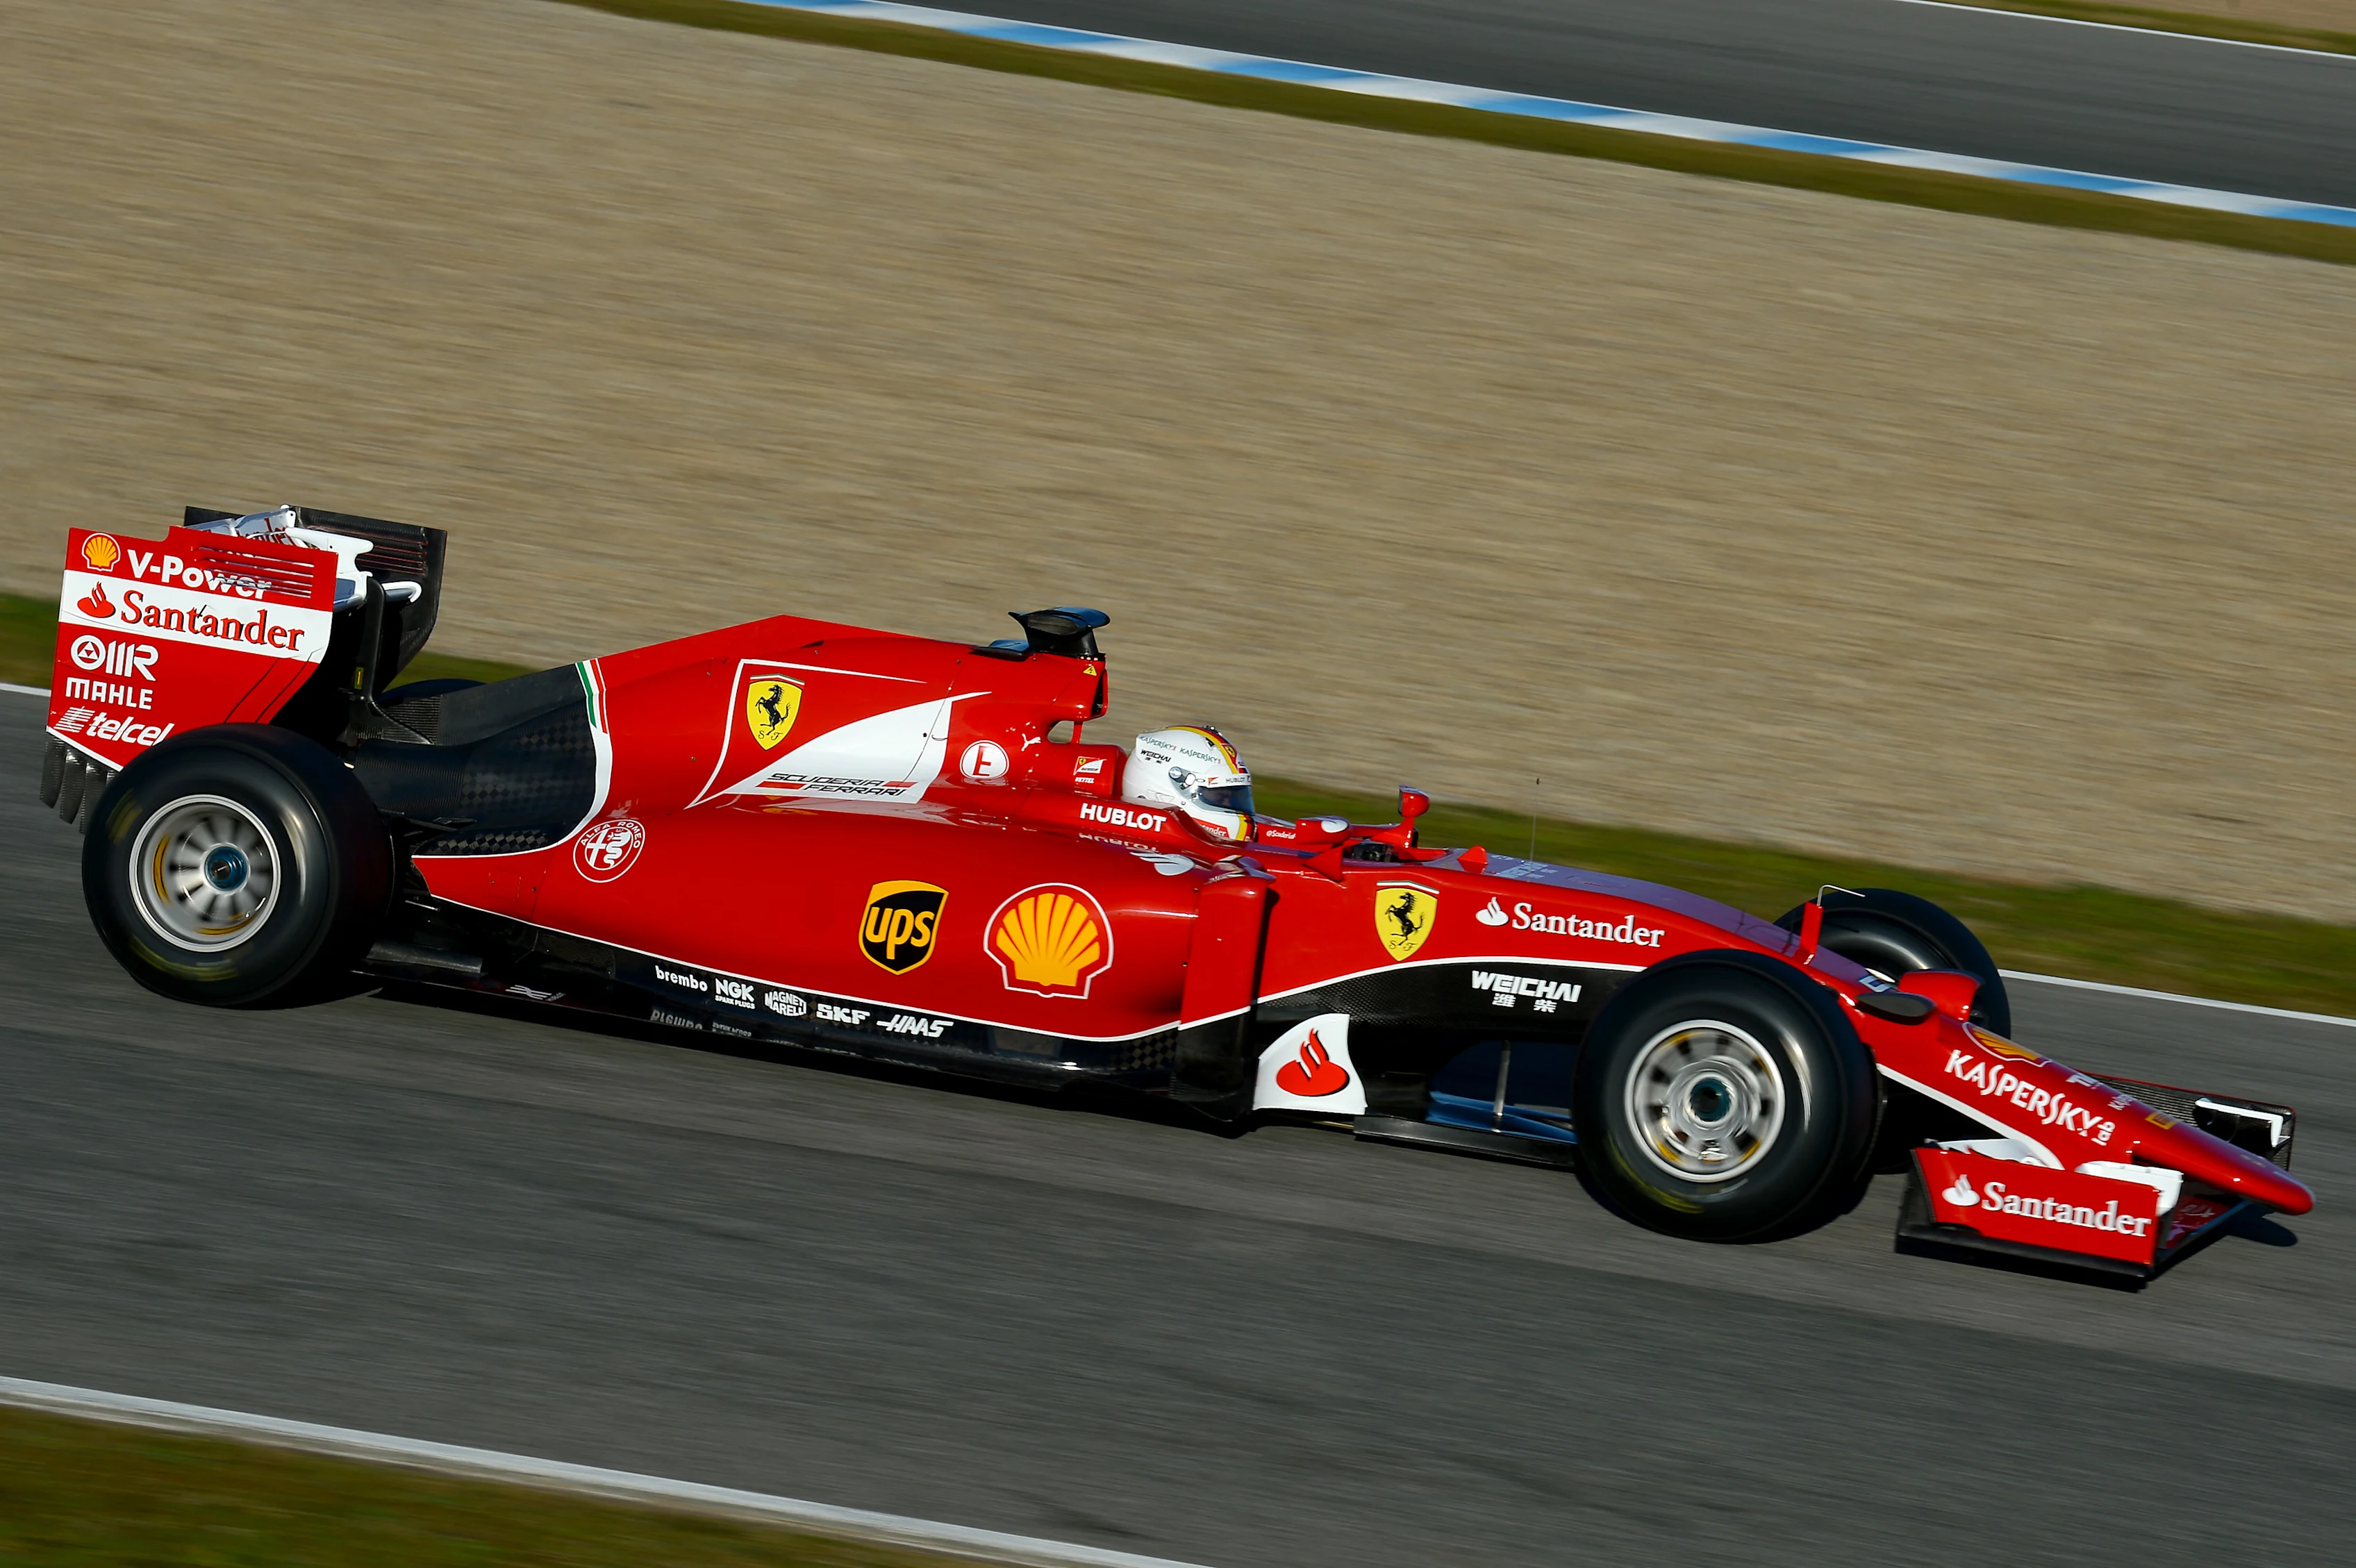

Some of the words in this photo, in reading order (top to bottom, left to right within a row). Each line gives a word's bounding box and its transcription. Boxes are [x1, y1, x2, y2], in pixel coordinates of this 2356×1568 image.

[127, 549, 272, 599] V-Power
[121, 590, 304, 651] Santander
[65, 676, 154, 710] MAHLE
[86, 712, 175, 747] telcel
[972, 746, 997, 777] E
[767, 772, 886, 787] SCUDERIA
[803, 783, 907, 796] FERRARI
[1079, 803, 1168, 832] HUBLOT
[581, 823, 611, 846] ALFA
[617, 821, 642, 849] ROMEO
[865, 906, 936, 960] ups
[1512, 902, 1666, 948] Santander
[655, 965, 708, 992] brembo
[715, 978, 755, 1002] NGK
[1472, 970, 1582, 1003] WEICHAI
[715, 994, 734, 1005] SPARK
[734, 999, 756, 1010] PLUGS
[765, 991, 807, 1008] MAGNETI
[765, 999, 807, 1017] MARELLI
[816, 1003, 870, 1024] SKF
[876, 1015, 954, 1037] HAAS
[1944, 1049, 2104, 1137] KASPERSKY
[2091, 1121, 2116, 1146] lab
[1981, 1181, 2152, 1237] Santander
